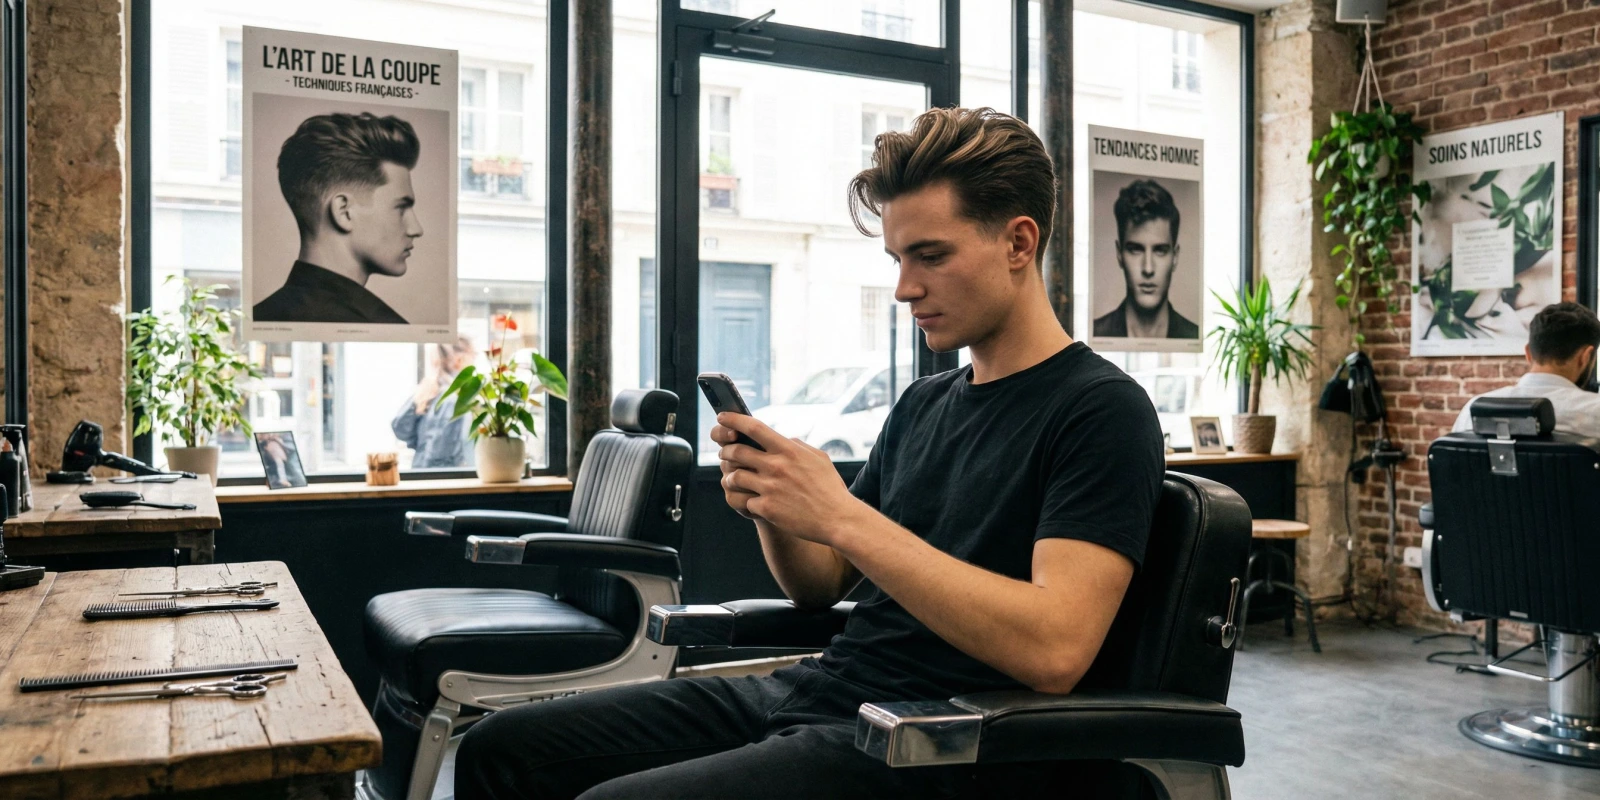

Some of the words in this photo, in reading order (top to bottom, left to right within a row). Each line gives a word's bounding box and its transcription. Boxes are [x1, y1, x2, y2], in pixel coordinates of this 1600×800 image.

[322, 52, 346, 76] DE
[352, 55, 375, 79] LA
[381, 59, 441, 86] COUPE
[293, 76, 352, 93] TECHNIQUES
[355, 82, 413, 99] FRANÇAISES
[1094, 137, 1158, 161] TENDANCES
[1160, 146, 1199, 166] HOMME
[1429, 142, 1467, 164] SOINS
[1471, 130, 1542, 158] NATURELS
